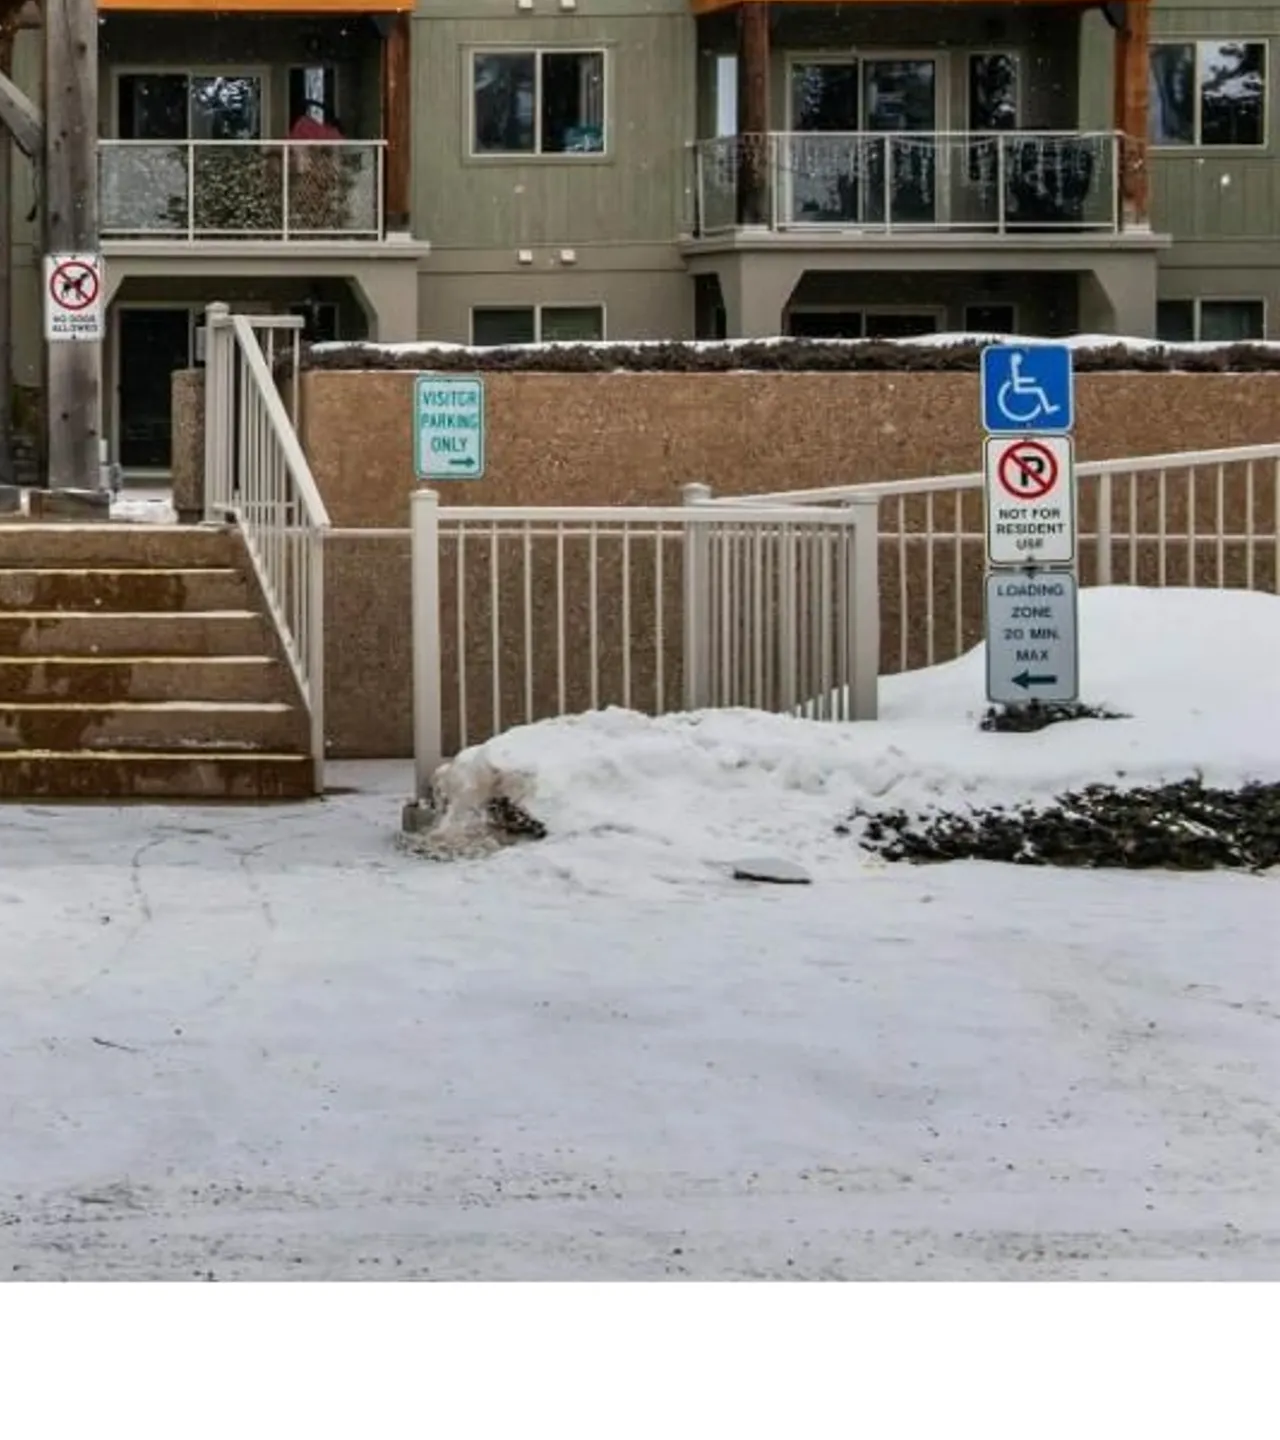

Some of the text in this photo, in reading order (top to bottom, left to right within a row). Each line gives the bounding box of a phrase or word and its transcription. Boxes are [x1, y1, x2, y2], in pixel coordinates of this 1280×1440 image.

[53, 314, 66, 322] NO
[52, 324, 98, 332] ALLOWED
[423, 391, 476, 406] VISITOR
[421, 413, 478, 428] PARKING
[431, 436, 467, 452] ONLY
[999, 509, 1060, 519] NOT FOR
[996, 523, 1065, 534] RESIDENT
[1016, 539, 1043, 550] USE
[997, 584, 1064, 596] LOADING
[1011, 606, 1053, 618] ZONE
[1004, 628, 1024, 640] 20
[1016, 650, 1049, 661] MAX
